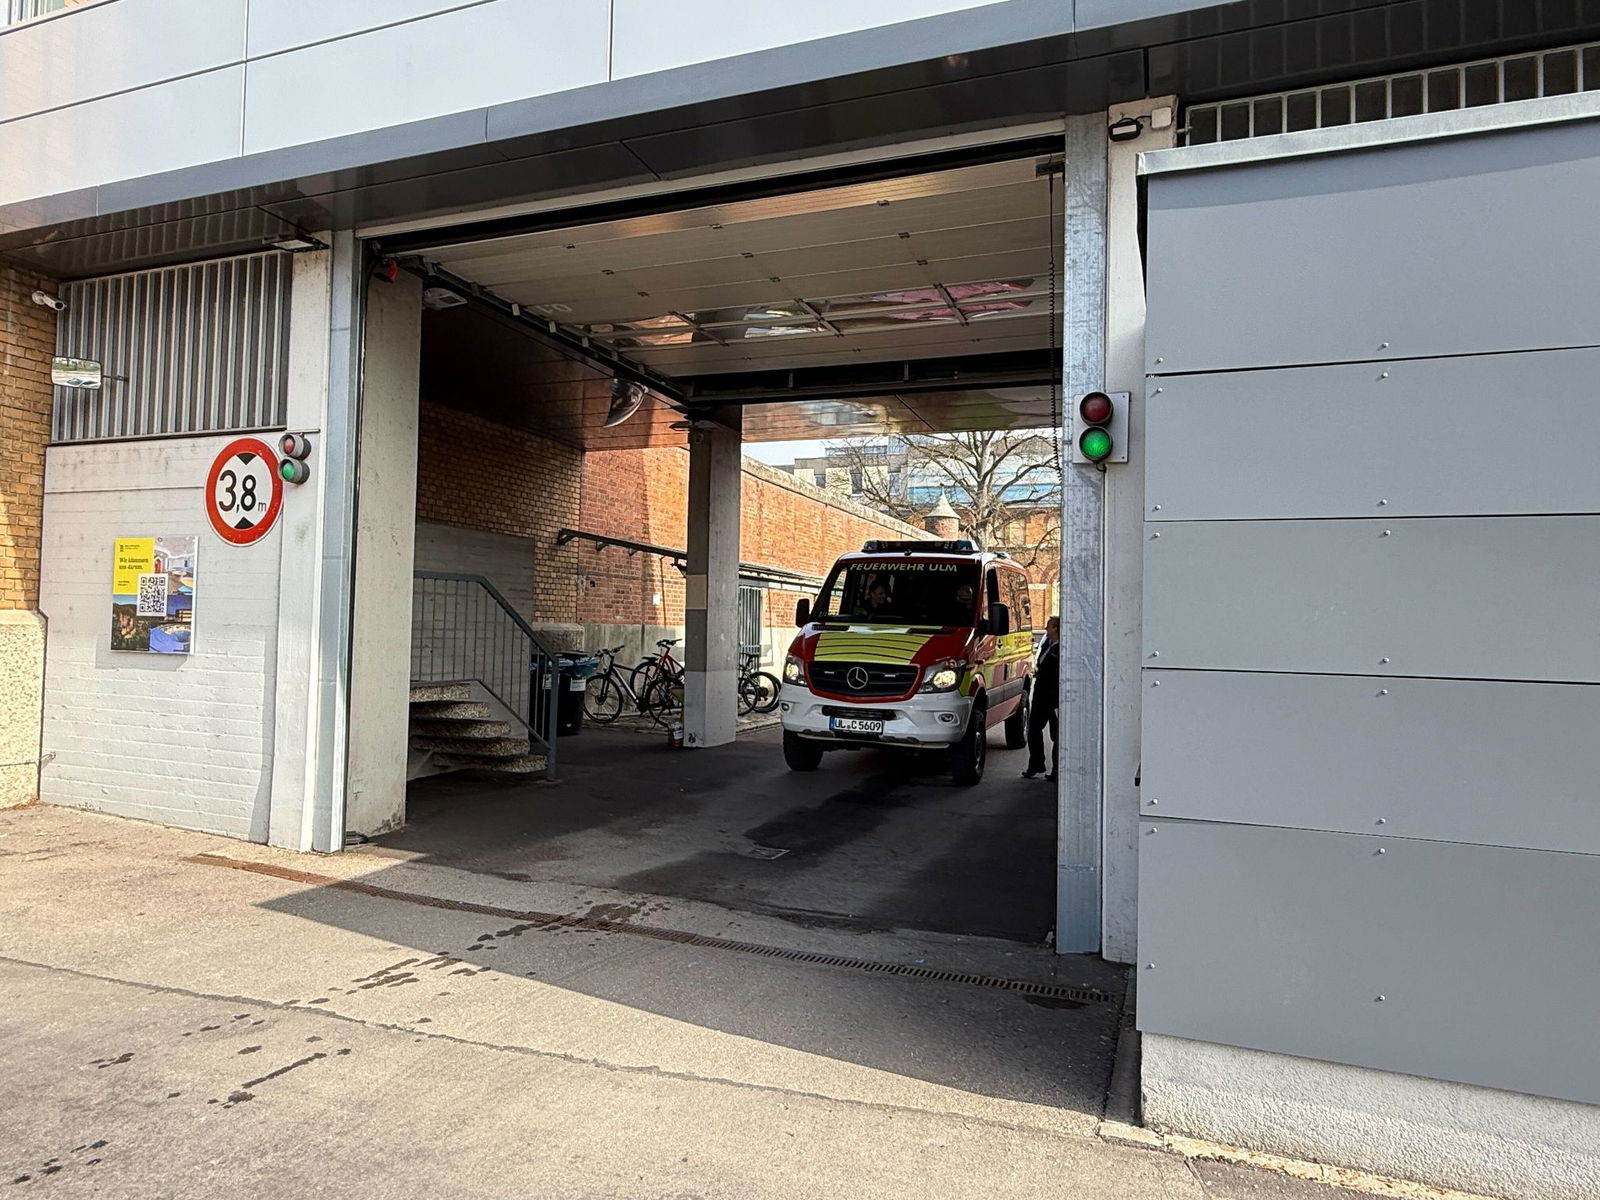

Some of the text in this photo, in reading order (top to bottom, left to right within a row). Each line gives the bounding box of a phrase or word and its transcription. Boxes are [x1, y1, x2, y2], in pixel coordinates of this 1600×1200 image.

[218, 469, 267, 513] 3,8 m
[849, 562, 958, 572] FEUERWEHR ULM
[834, 719, 846, 729] UL
[858, 720, 881, 731] 5609
